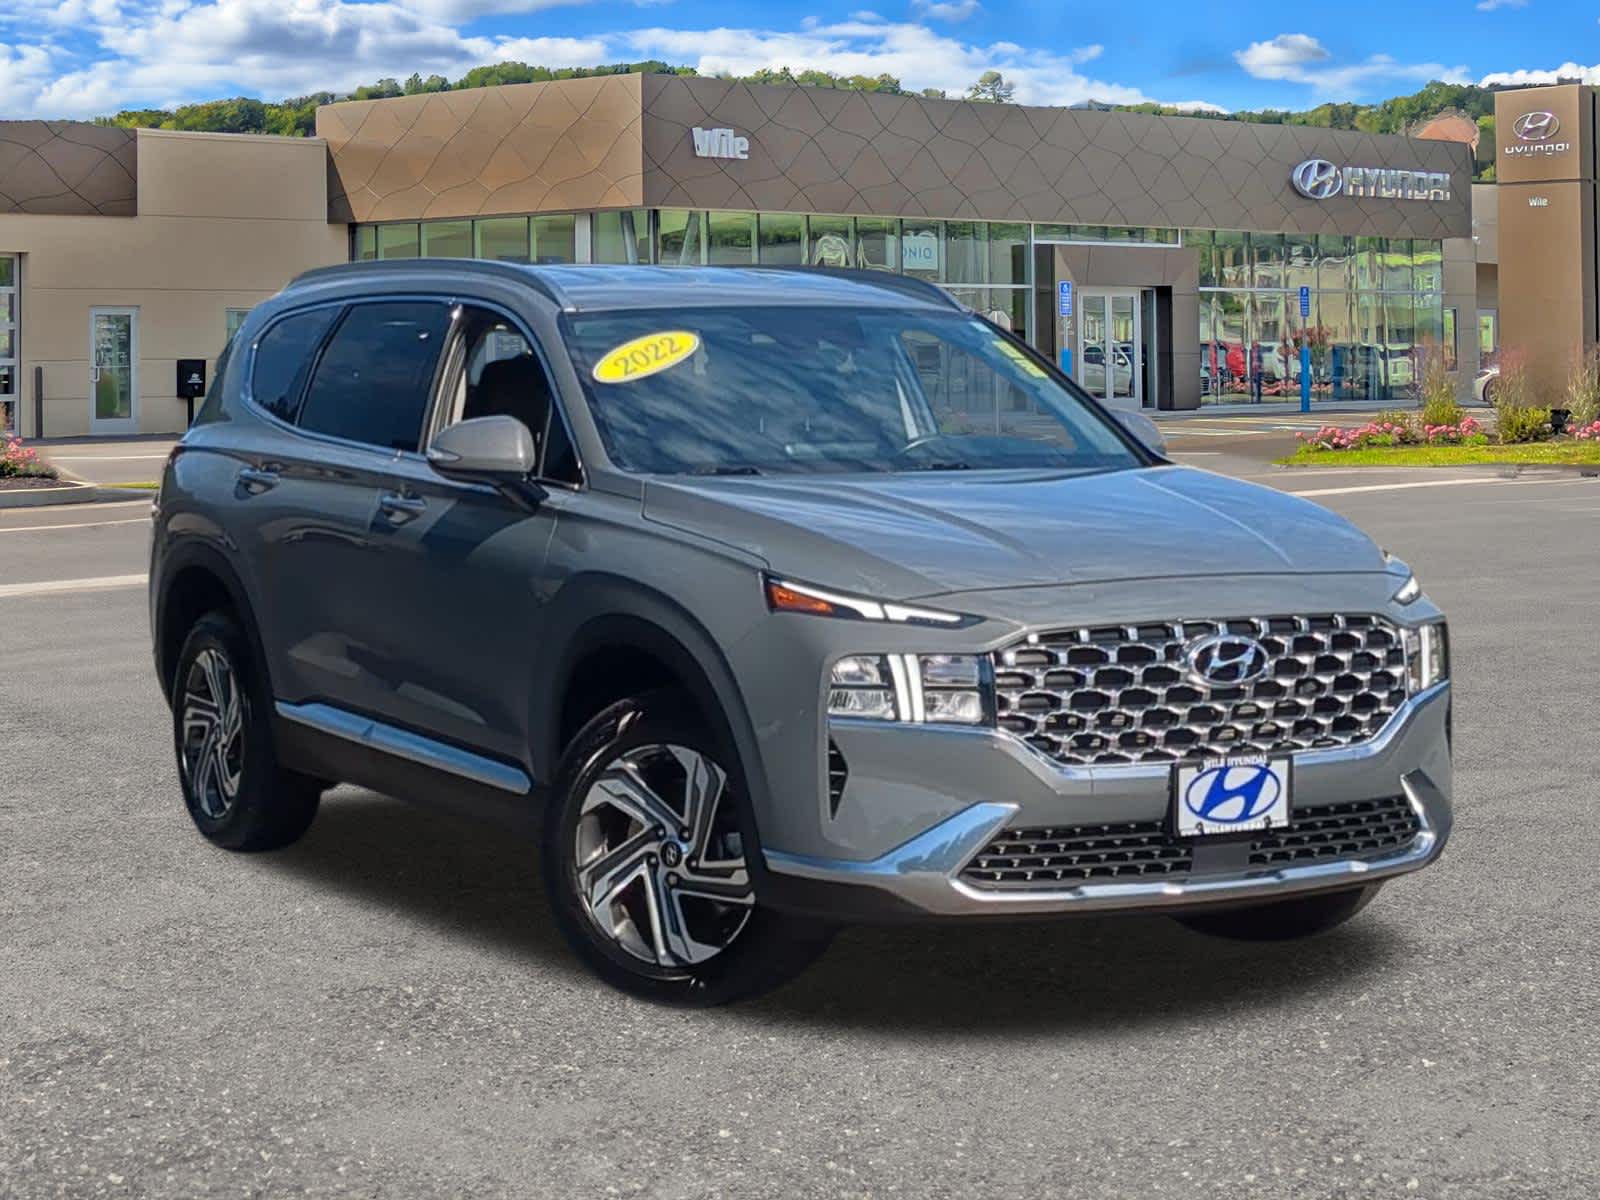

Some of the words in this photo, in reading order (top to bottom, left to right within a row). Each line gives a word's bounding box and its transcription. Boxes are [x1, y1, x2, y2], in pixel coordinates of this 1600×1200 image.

[692, 127, 749, 159] Wile
[1342, 167, 1450, 200] HYUNDAI
[614, 338, 682, 376] 2022
